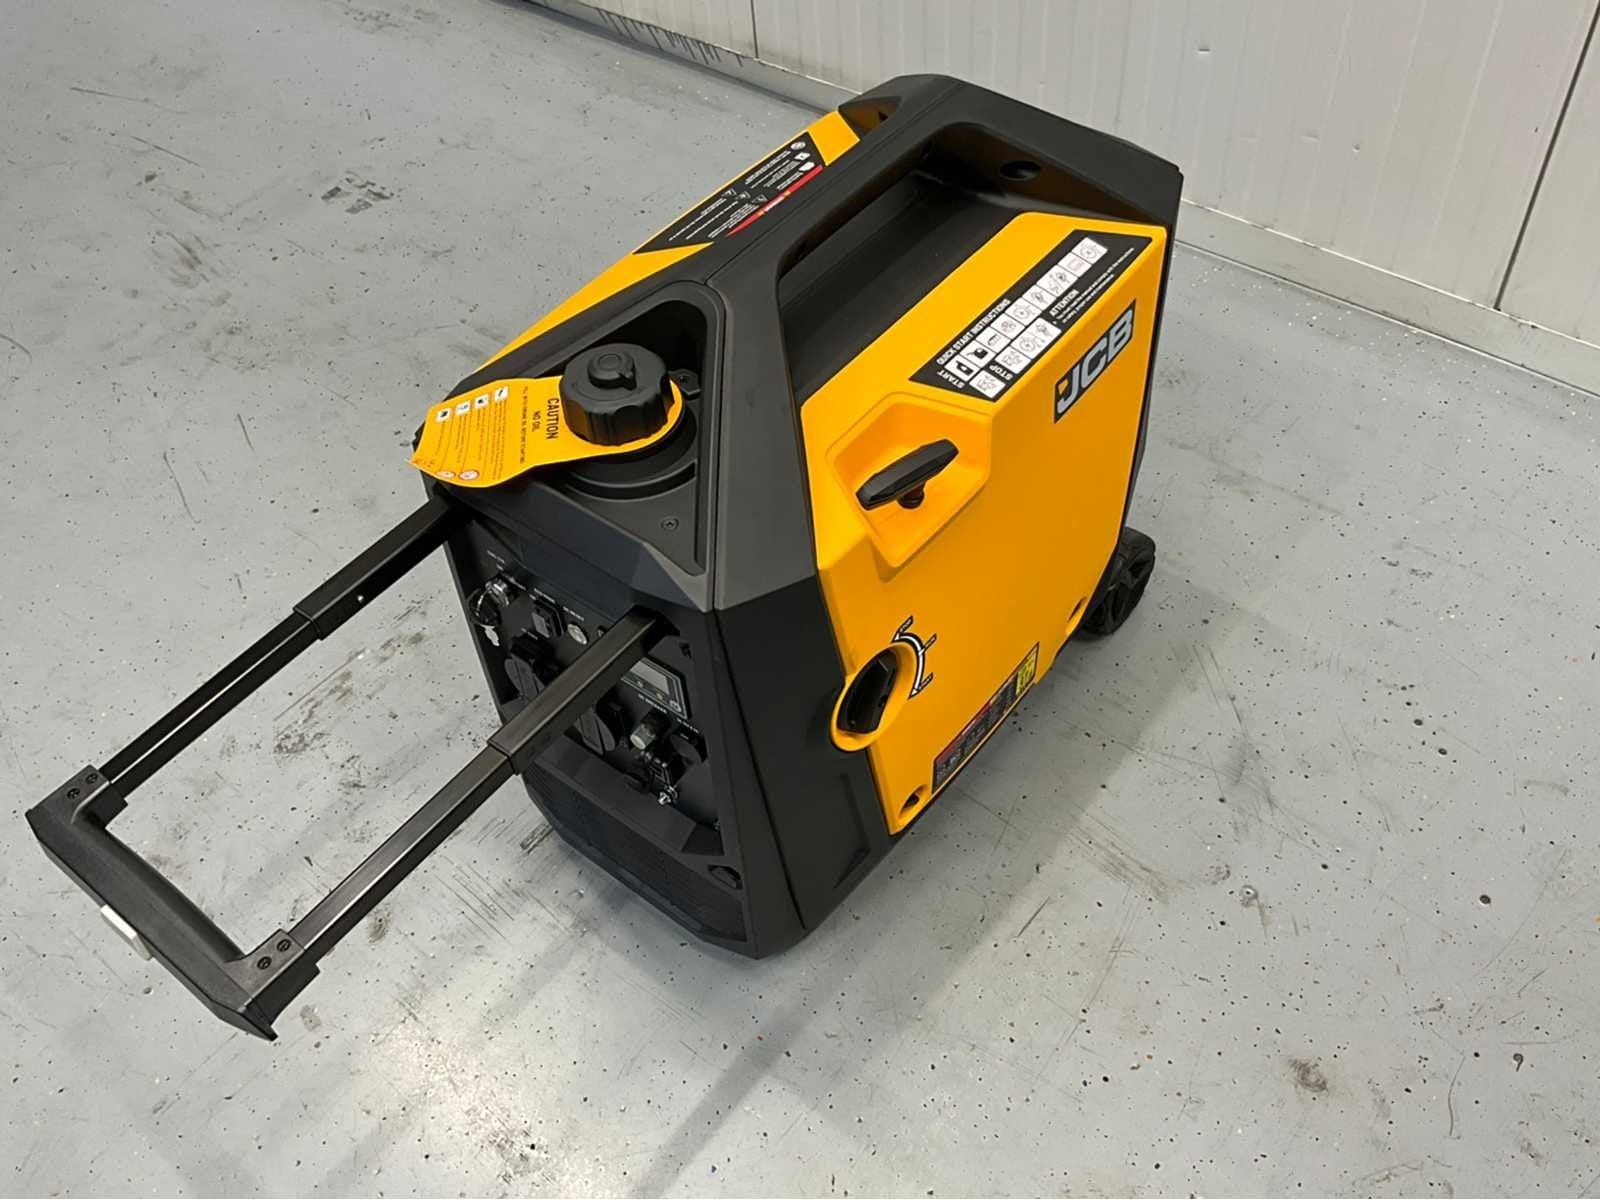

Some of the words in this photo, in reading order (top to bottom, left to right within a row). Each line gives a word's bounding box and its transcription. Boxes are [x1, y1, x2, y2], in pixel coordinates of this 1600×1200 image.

[1049, 289, 1080, 317] ATTENTION
[936, 346, 958, 365] QUICK
[952, 331, 975, 351] START
[970, 298, 1012, 335] INSTRUCTIONS
[989, 364, 1014, 381] STOP
[1056, 309, 1134, 414] JCB
[937, 369, 966, 389] START
[531, 421, 541, 432] OIL
[532, 410, 541, 421] NO
[546, 398, 560, 440] CAUTION
